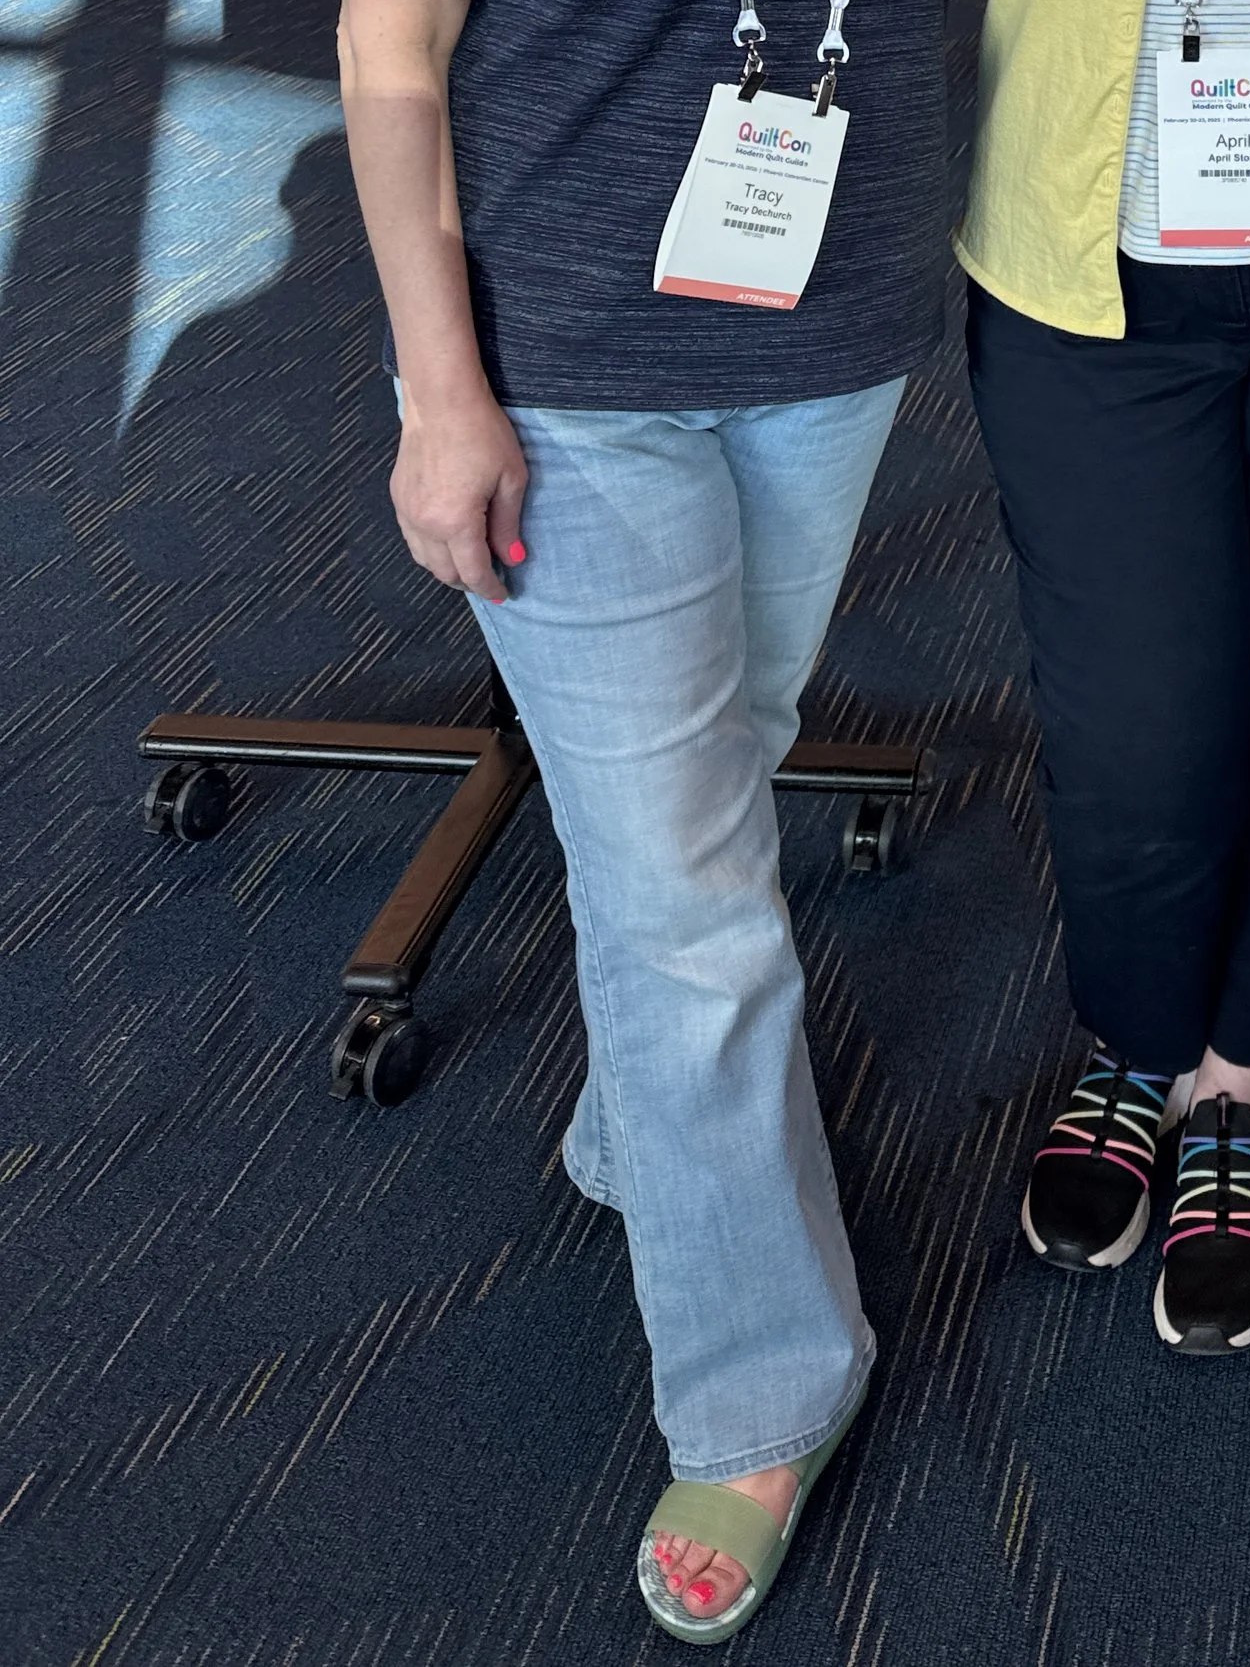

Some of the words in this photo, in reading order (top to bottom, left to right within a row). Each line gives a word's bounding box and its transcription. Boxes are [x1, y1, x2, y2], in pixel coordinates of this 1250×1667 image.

[1226, 102, 1247, 110] Quilt
[738, 122, 811, 155] QuiltCon
[1216, 134, 1250, 150] April
[735, 147, 764, 159] Modern
[765, 153, 784, 163] Quilt
[1208, 154, 1231, 163] April
[745, 183, 784, 207] Tracy
[725, 201, 750, 215] Tracy
[751, 205, 792, 221] Dechurch
[736, 293, 786, 306] ATTENDEE
